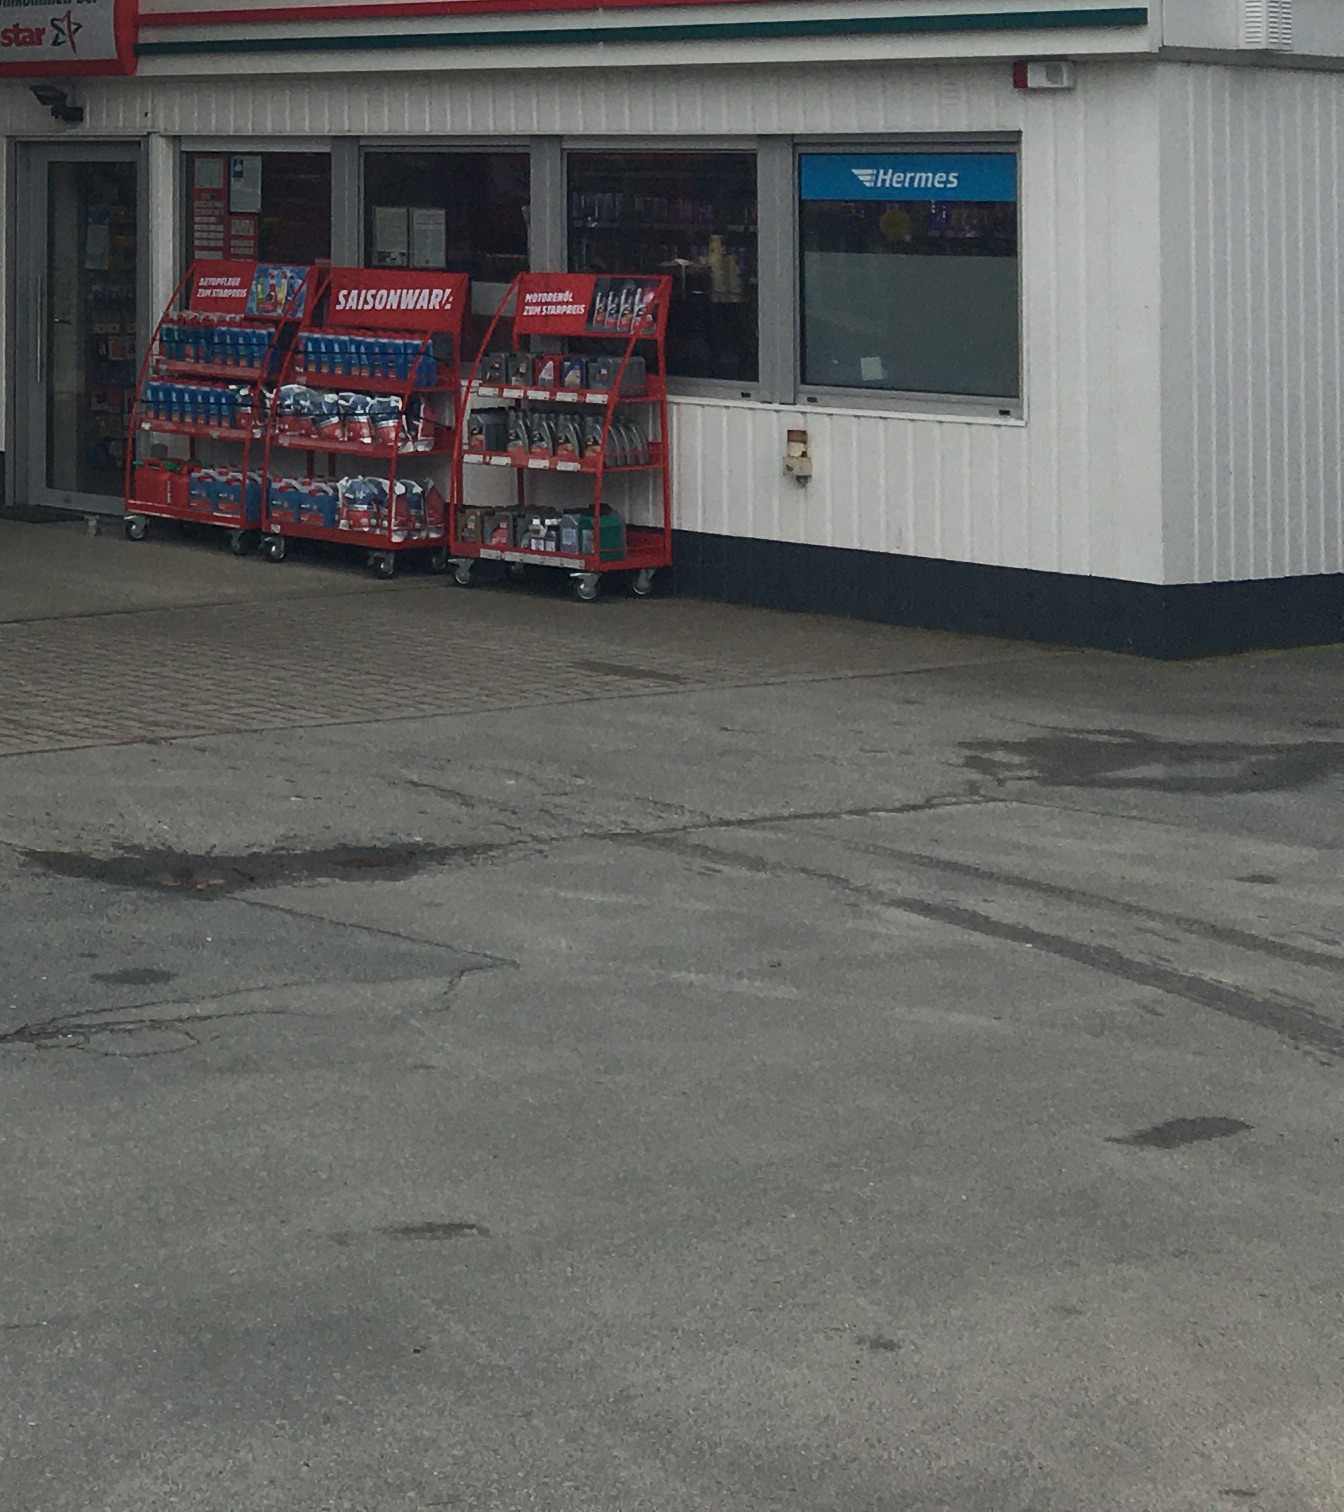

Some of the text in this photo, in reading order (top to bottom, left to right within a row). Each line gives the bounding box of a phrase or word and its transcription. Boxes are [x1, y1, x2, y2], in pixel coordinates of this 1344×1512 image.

[0, 22, 46, 47] star
[876, 168, 959, 189] Hermes
[524, 290, 574, 303] MOTORENÖL
[522, 304, 586, 316] ZUM STARPREIS
